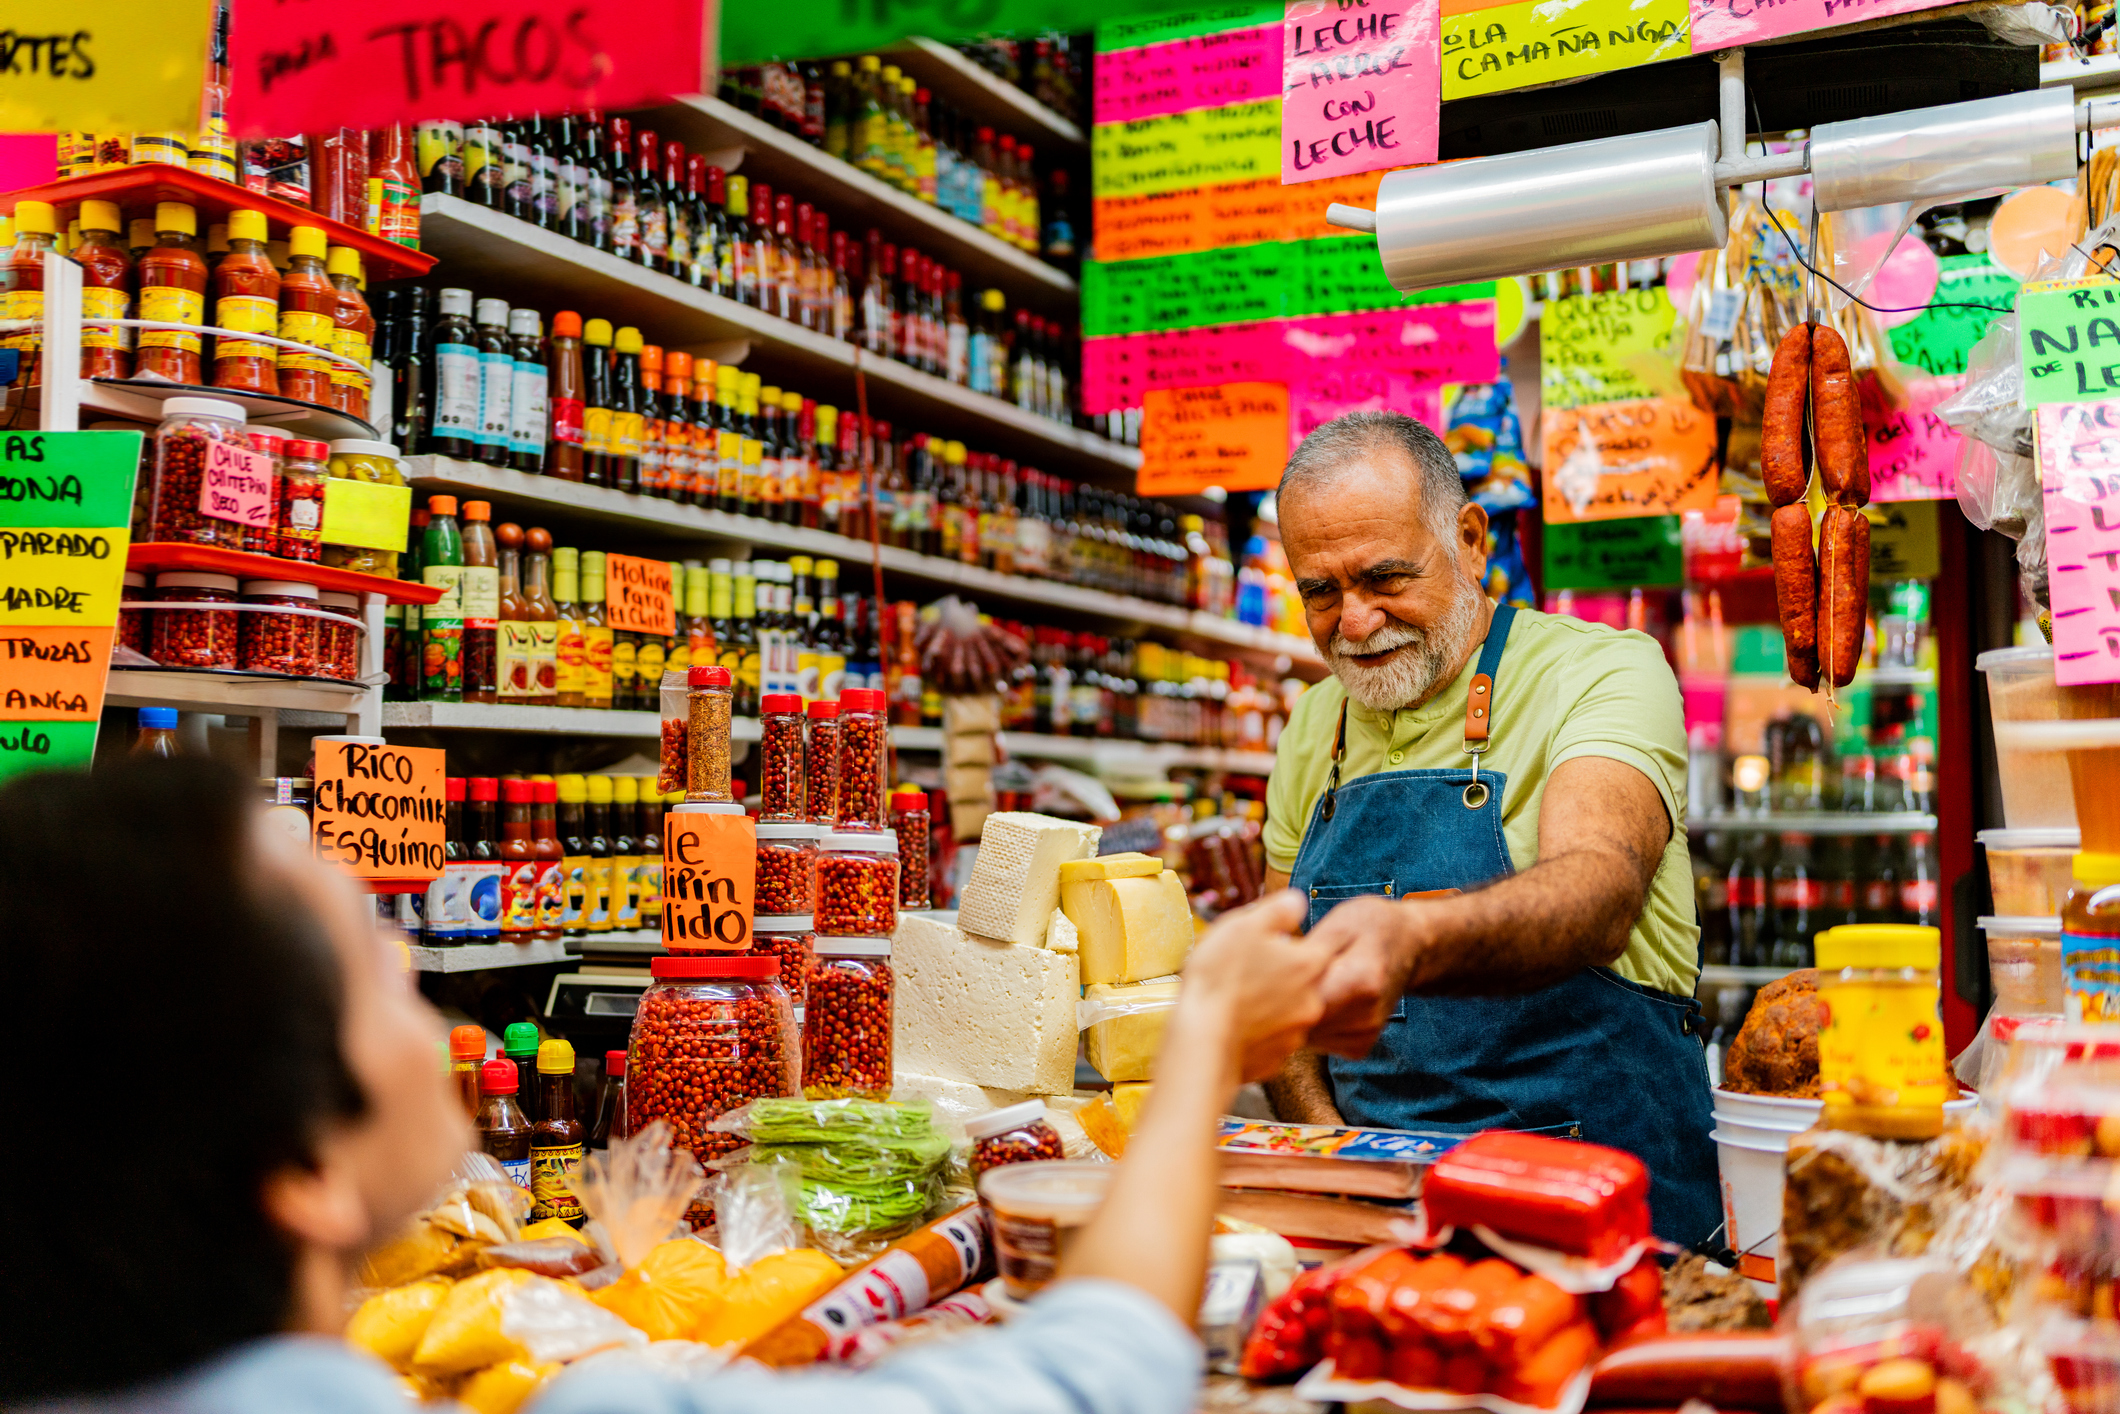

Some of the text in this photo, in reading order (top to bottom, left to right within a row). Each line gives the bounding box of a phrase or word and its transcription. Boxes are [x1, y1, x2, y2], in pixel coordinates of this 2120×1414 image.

[1294, 14, 1400, 57] LECHE
[366, 7, 605, 102] TACOS
[1293, 116, 1401, 171] LECHE
[2029, 360, 2064, 378] DE
[5, 435, 46, 462] AS
[214, 445, 252, 472] CHILE
